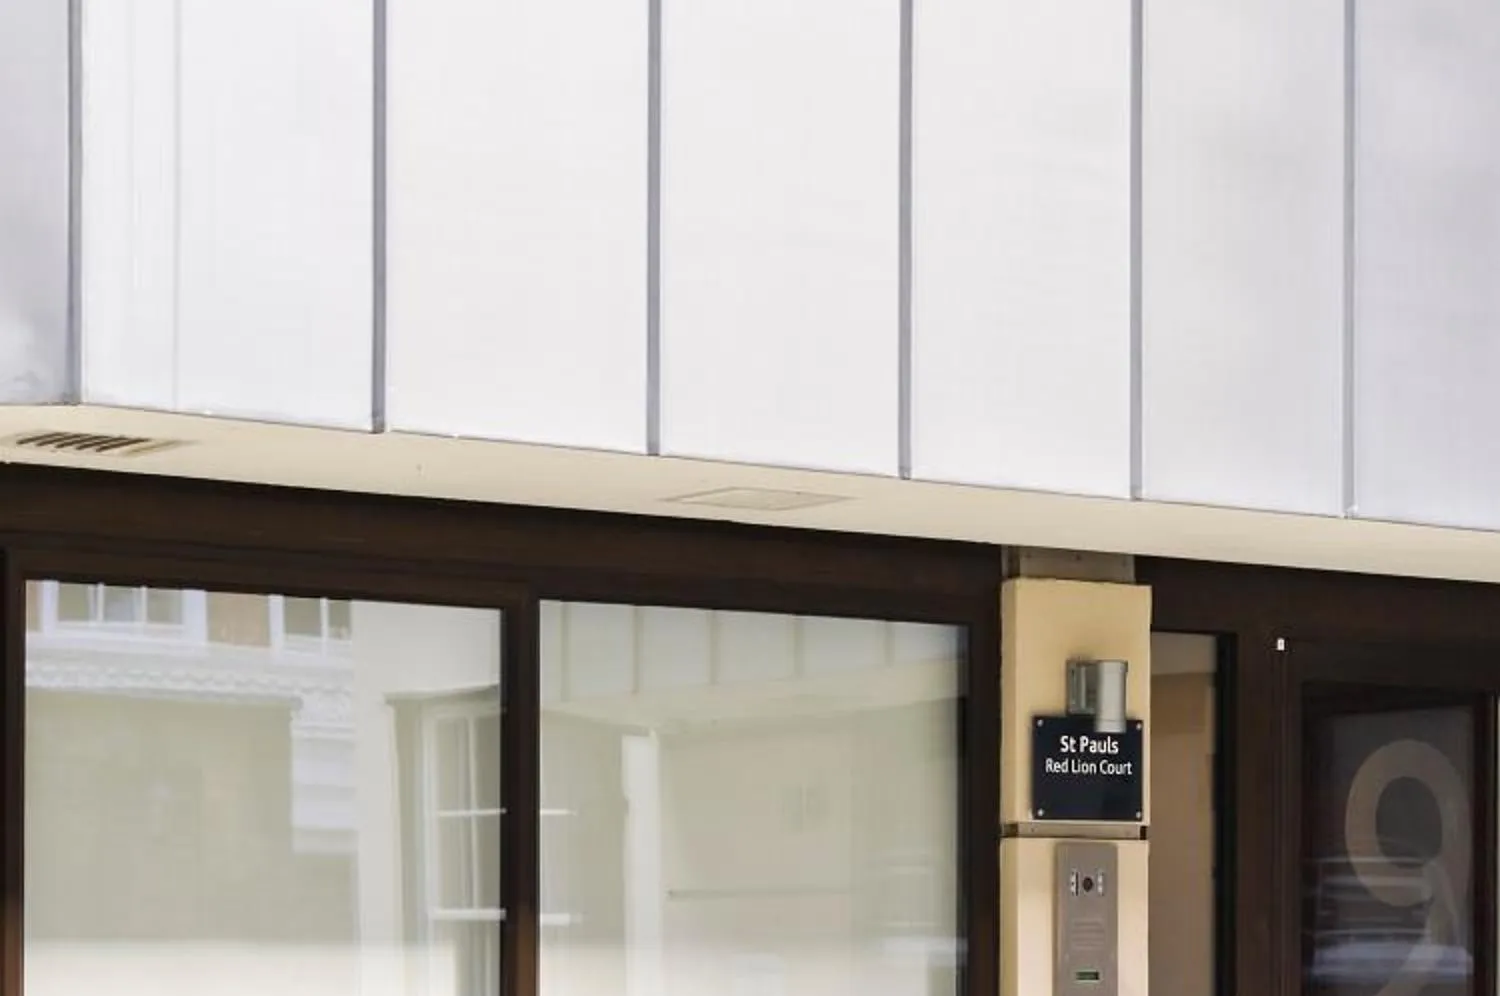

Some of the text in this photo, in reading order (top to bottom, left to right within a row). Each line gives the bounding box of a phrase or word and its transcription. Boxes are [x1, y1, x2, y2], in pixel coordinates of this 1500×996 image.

[1060, 735, 1119, 754] St Pauls
[1045, 757, 1133, 775] Red Lion Court
